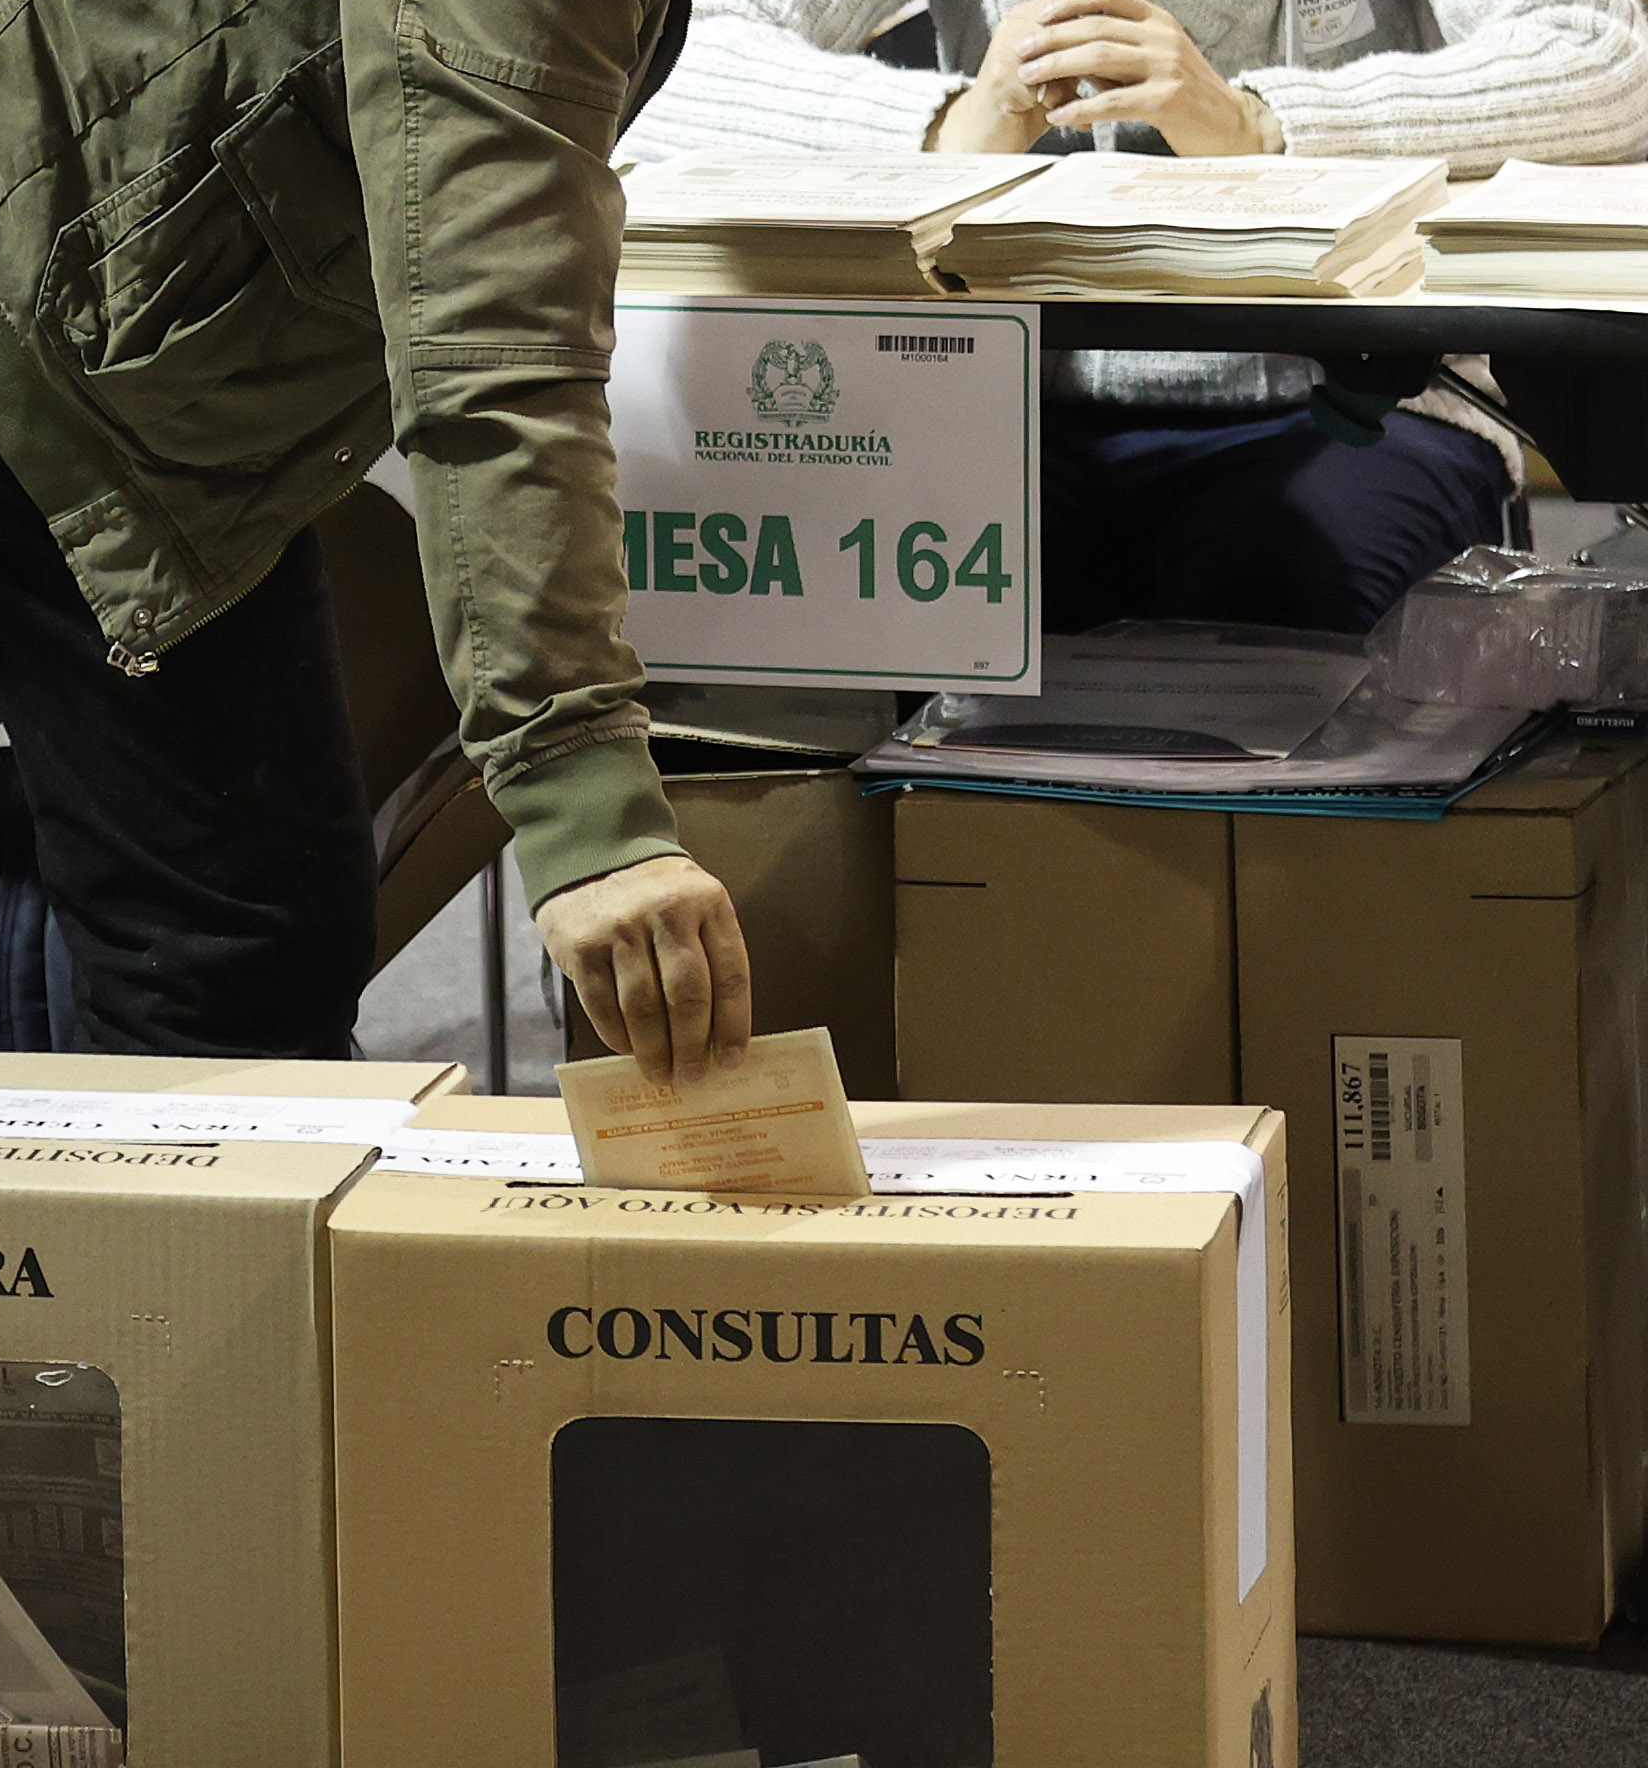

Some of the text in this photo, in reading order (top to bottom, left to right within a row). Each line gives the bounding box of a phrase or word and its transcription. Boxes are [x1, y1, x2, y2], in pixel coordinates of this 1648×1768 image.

[694, 429, 893, 454] REGISTRADURÍA
[694, 451, 893, 467] NACIONAL DEL ESTADO CIVIL
[838, 517, 1012, 605] 164
[1341, 1062, 1365, 1150] 111,867
[150, 1123, 259, 1132] URNA
[983, 1172, 1100, 1182] URNA
[481, 1193, 1080, 1221] DEPOSITE SU VOTO AQUÍ
[546, 1306, 987, 1367] CONSULTAS
